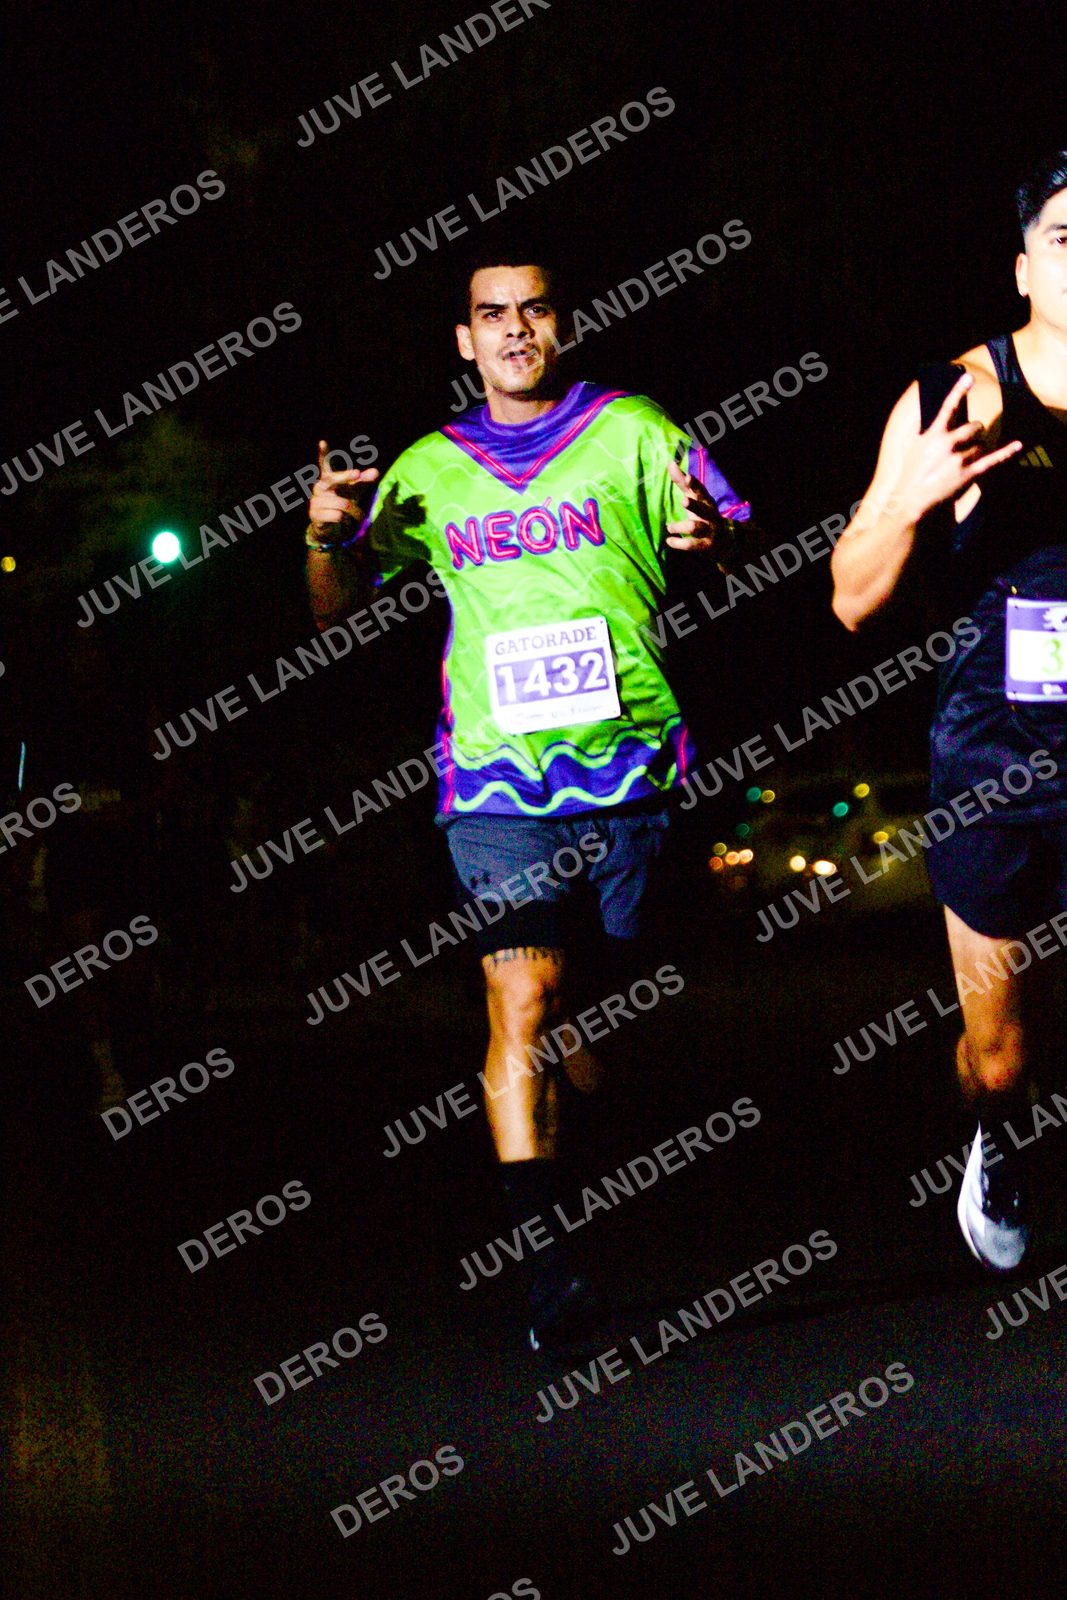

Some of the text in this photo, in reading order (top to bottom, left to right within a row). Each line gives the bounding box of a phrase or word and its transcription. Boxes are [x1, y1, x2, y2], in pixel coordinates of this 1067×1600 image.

[445, 497, 606, 570] NEÓN
[495, 626, 597, 656] GATORADE
[498, 651, 607, 702] 1432
